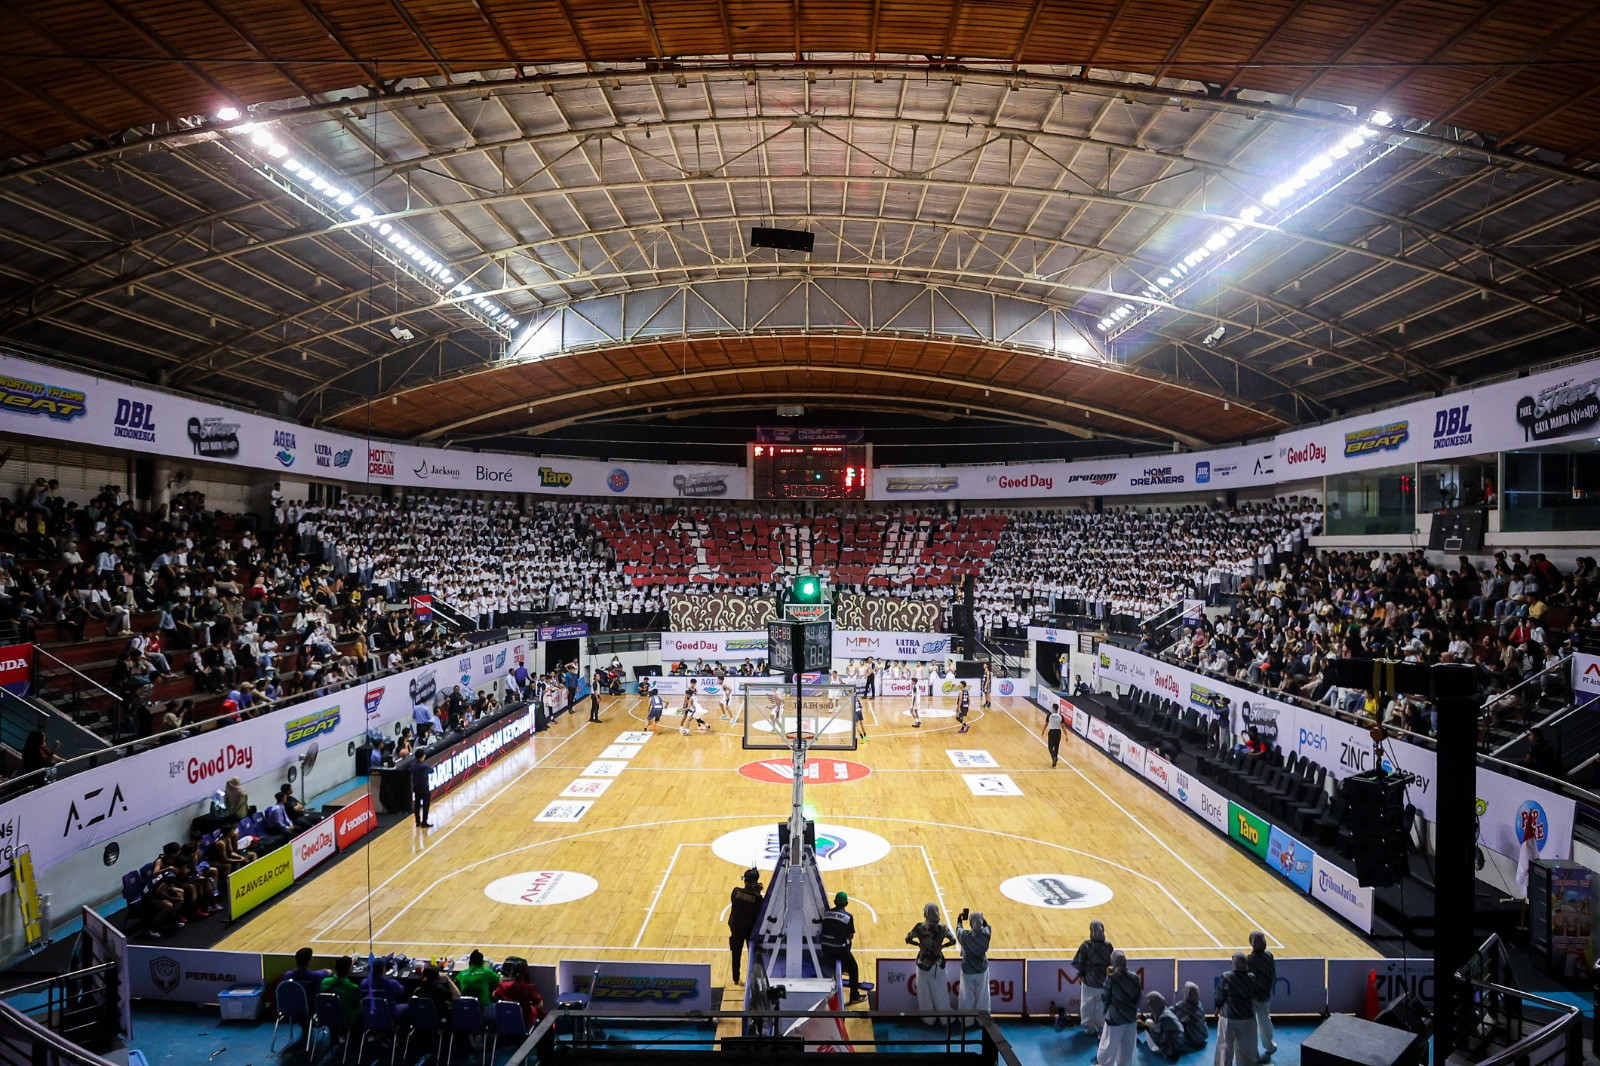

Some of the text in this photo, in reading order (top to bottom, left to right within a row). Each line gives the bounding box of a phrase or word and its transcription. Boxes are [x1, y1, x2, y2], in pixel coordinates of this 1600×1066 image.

[114, 398, 155, 432] DBL
[1519, 405, 1532, 418] PAKE
[1434, 404, 1472, 438] DBL
[1535, 419, 1548, 434] GAYA
[1550, 413, 1569, 430] MAKIN
[114, 427, 155, 443] INDONESIA
[273, 430, 296, 452] AQUA
[1434, 434, 1473, 449] INDONESIA
[370, 449, 385, 463] HOT
[1288, 446, 1308, 464] Good
[1309, 443, 1326, 463] Day
[370, 463, 394, 476] CREAM
[431, 465, 460, 477] Jackson
[476, 465, 513, 482] Bioré
[541, 467, 572, 485] Taro
[1068, 472, 1117, 484] proteam
[1143, 467, 1172, 477] HOME
[999, 475, 1028, 489] Good
[1030, 474, 1053, 489] Day
[1130, 475, 1184, 487] DREAMERS
[676, 640, 698, 651] Good
[700, 640, 718, 652] Day
[846, 637, 880, 648] MPM
[896, 639, 920, 647] ULTRA
[897, 647, 917, 655] MILK
[1155, 670, 1168, 690] Good
[1168, 675, 1179, 698] Day
[288, 716, 339, 743] BeAT
[1299, 724, 1328, 755] posh
[187, 748, 225, 785] Good
[226, 745, 252, 769] Day
[1340, 742, 1370, 772] ZINC
[1202, 793, 1222, 822] Bioré
[346, 810, 374, 832] HONDA
[1238, 812, 1259, 844] Taro
[301, 832, 333, 862] Good Day
[235, 860, 290, 901] AZAWEAR.COM
[186, 971, 236, 983] PERBASI
